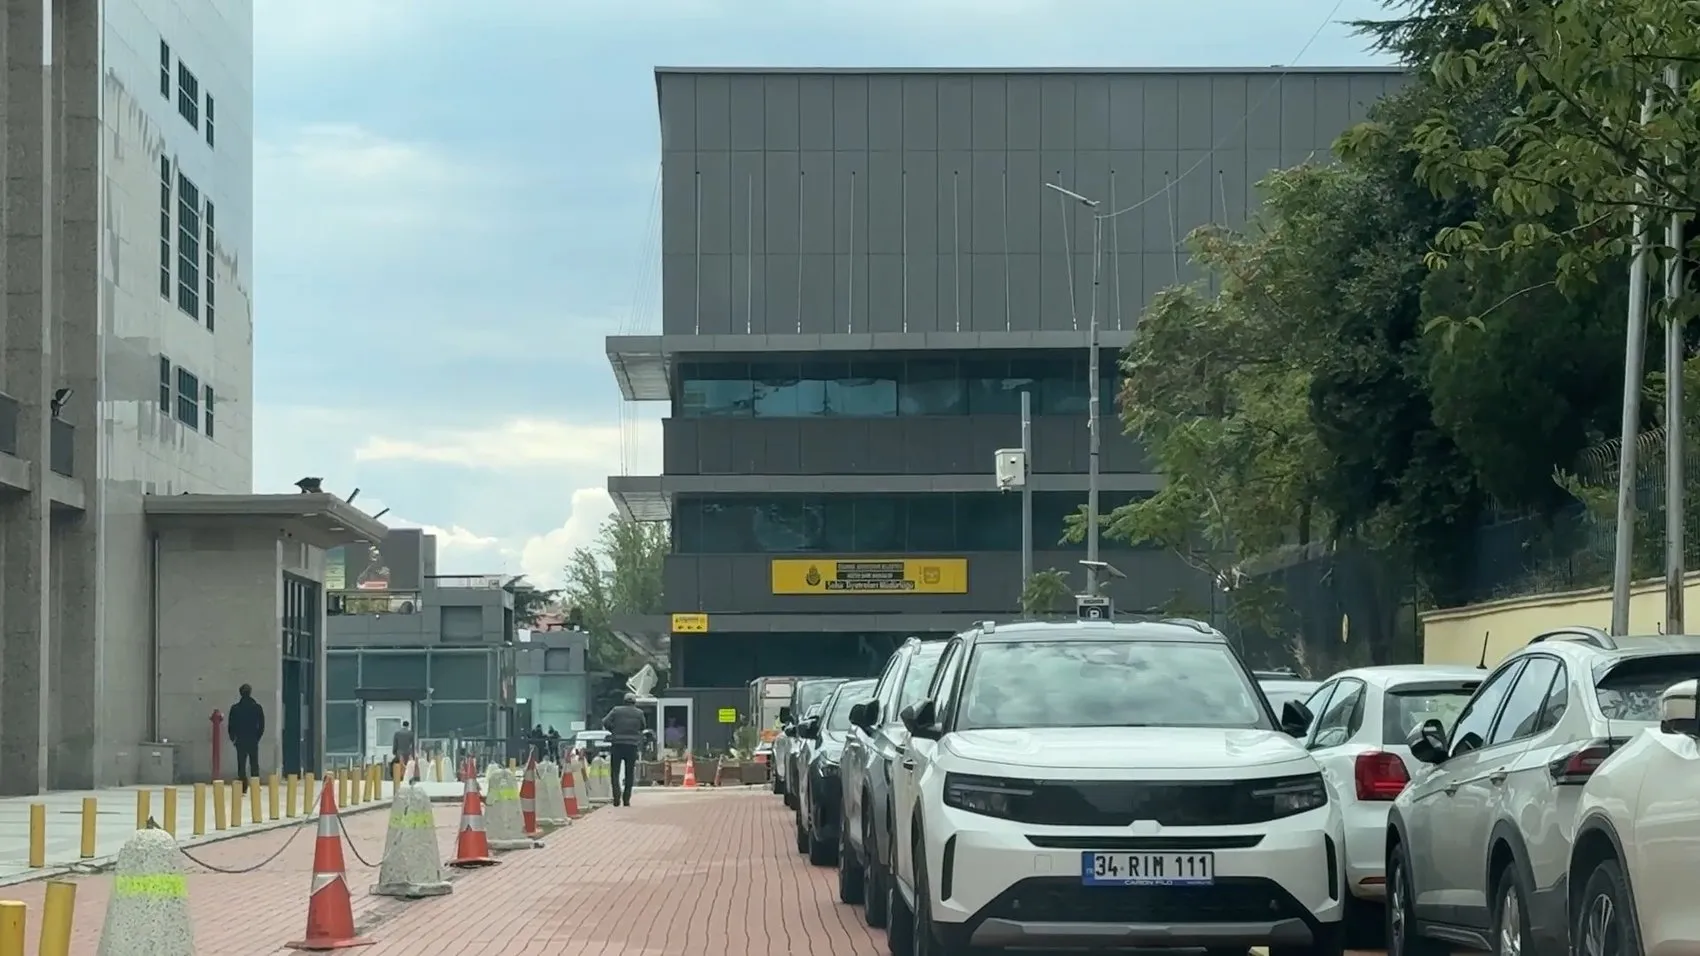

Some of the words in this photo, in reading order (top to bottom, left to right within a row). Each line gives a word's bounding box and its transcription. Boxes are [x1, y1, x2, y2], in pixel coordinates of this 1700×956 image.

[1095, 856, 1118, 877] 34
[1129, 856, 1164, 877] RIM
[1175, 856, 1207, 877] 111
